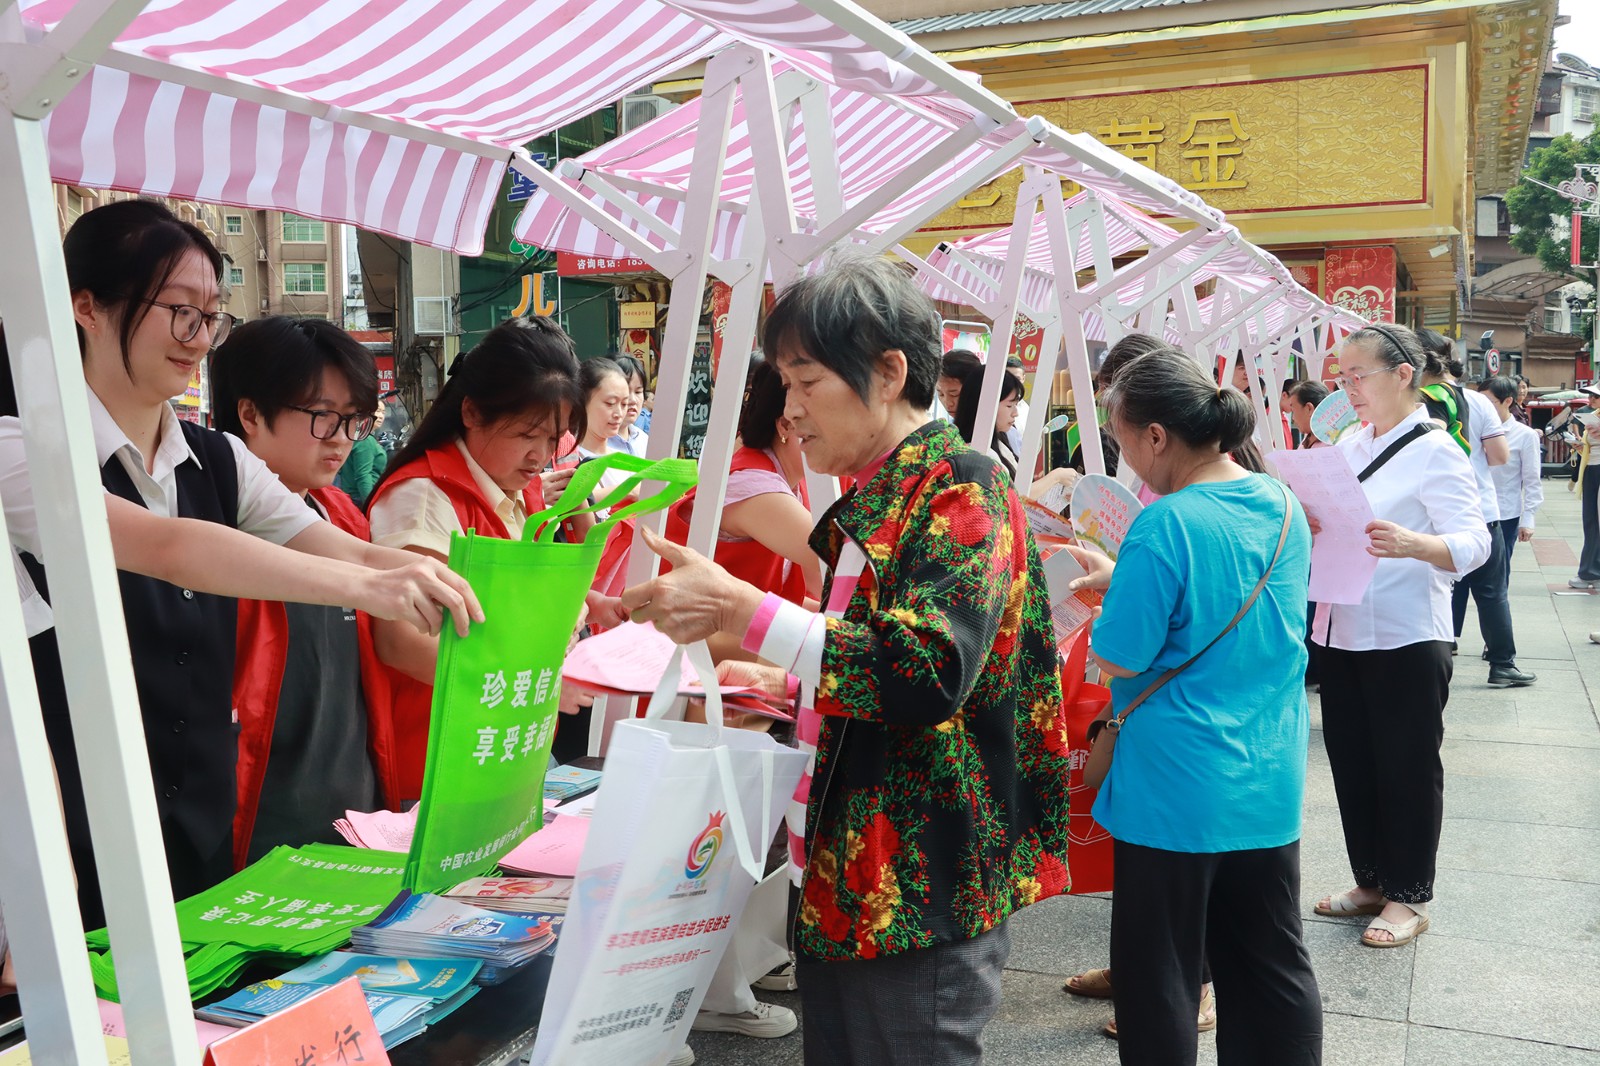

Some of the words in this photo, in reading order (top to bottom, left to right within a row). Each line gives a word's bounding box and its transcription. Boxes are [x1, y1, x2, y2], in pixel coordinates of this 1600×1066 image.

[472, 714, 556, 766] 享受幸福
[234, 890, 384, 916] 享受幸福人生
